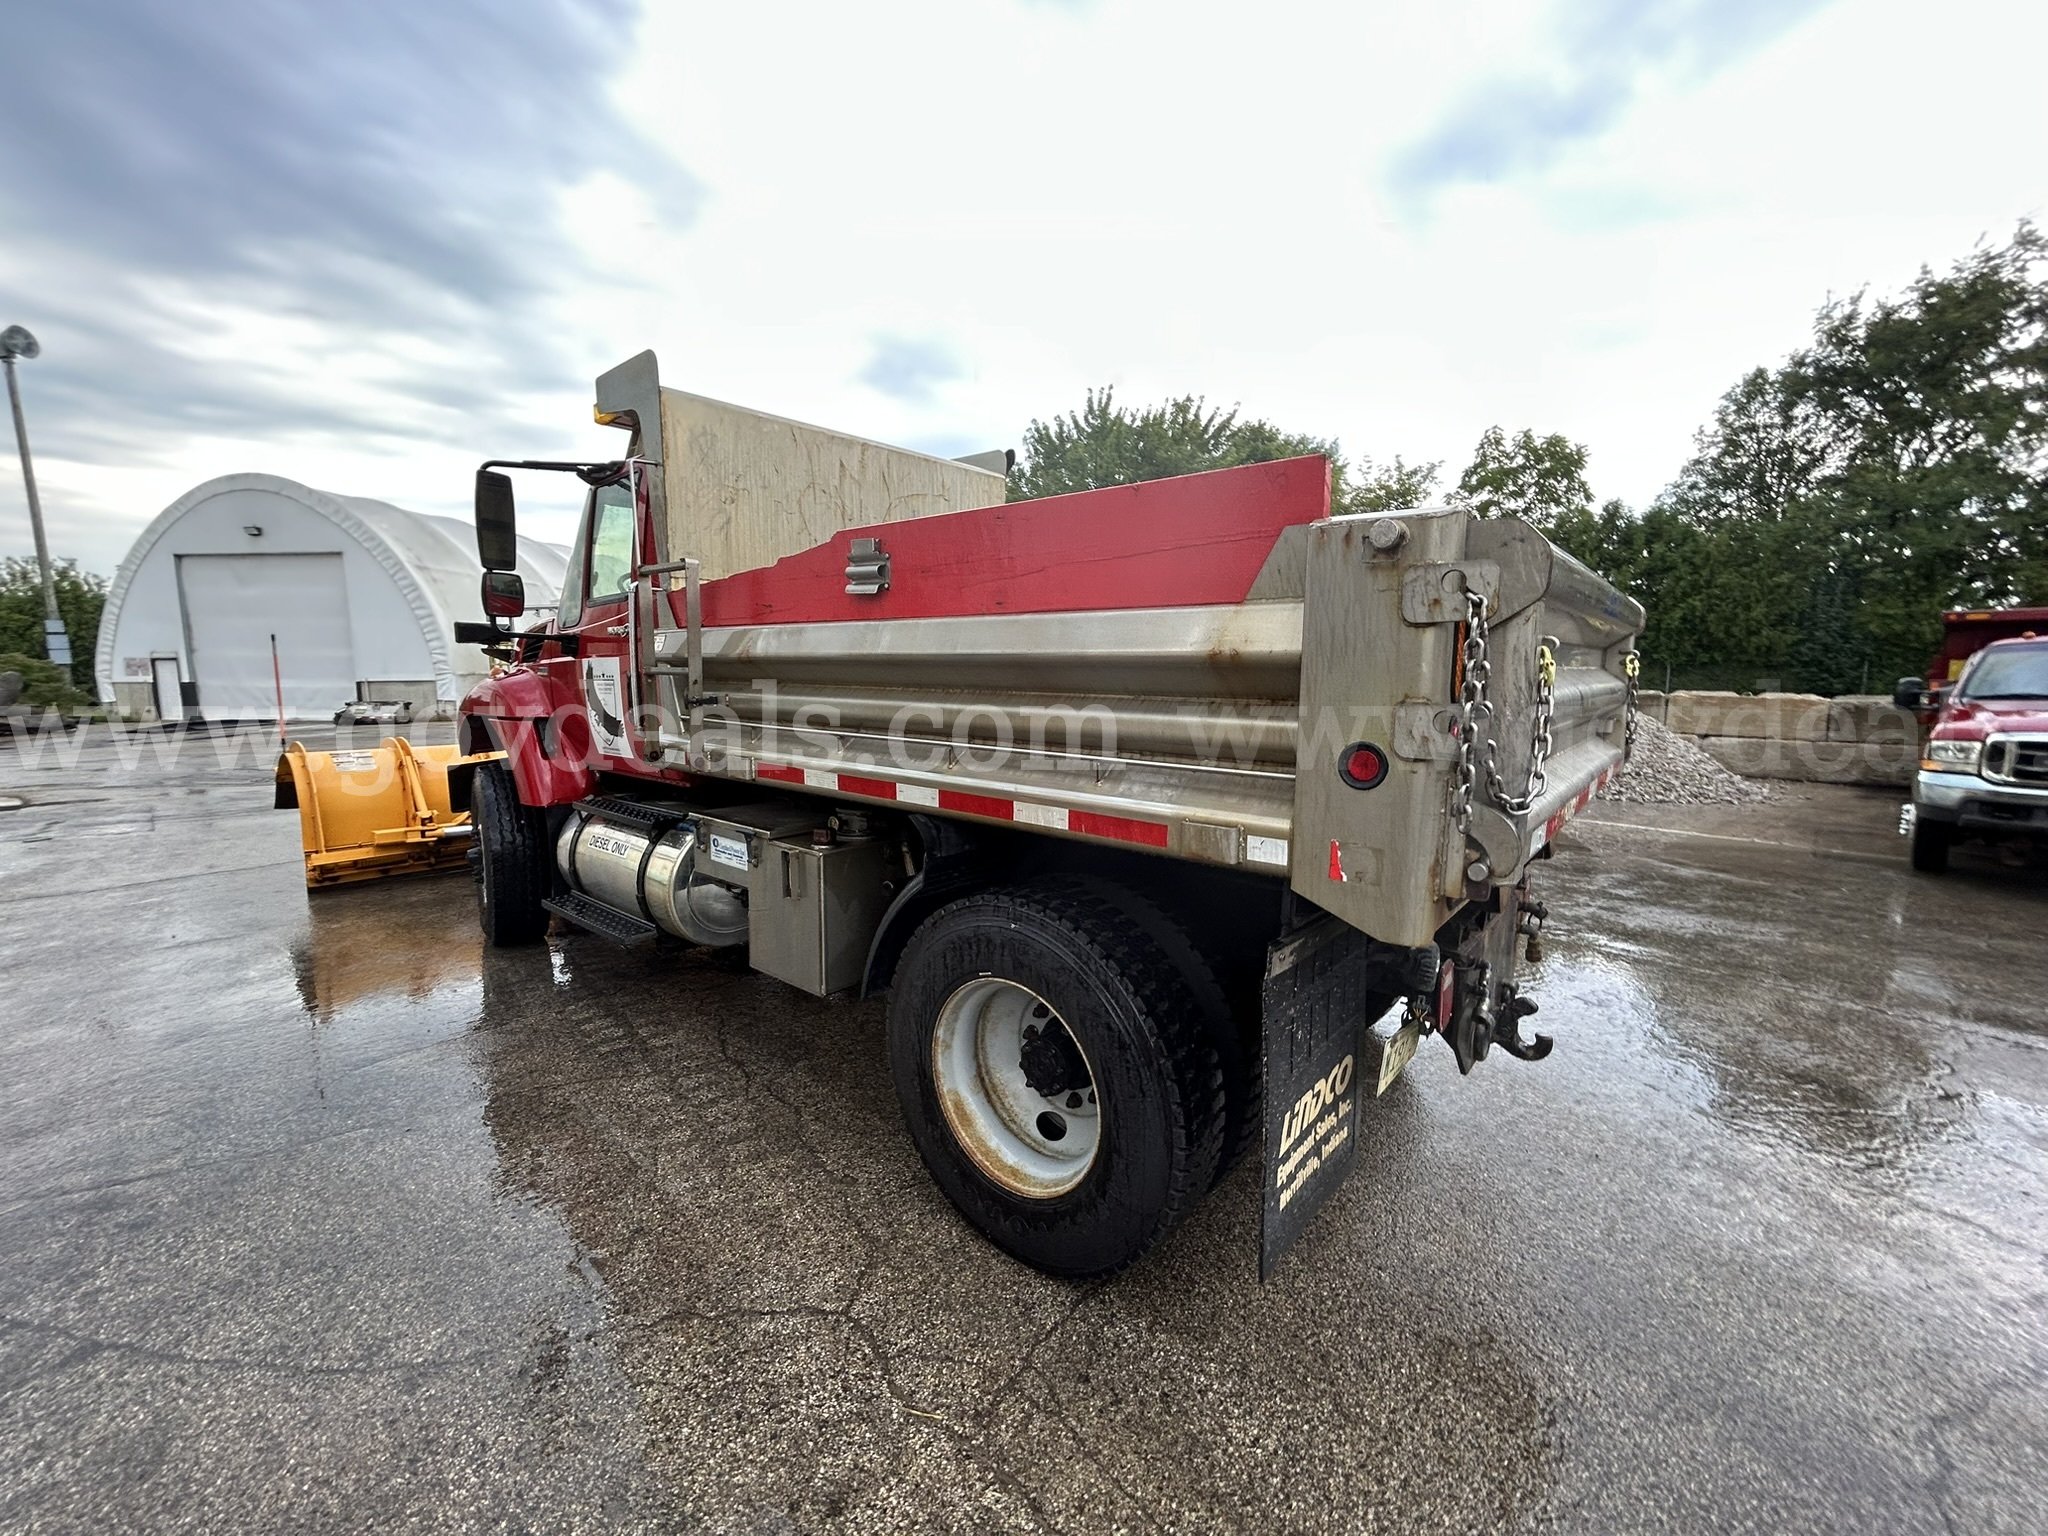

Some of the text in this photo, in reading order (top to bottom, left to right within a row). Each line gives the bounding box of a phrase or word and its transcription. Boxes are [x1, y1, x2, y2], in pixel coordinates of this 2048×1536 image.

[588, 834, 630, 856] DIESEL ONLY
[1276, 1128, 1315, 1188] Equipment
[1321, 1126, 1348, 1161] Indiana
